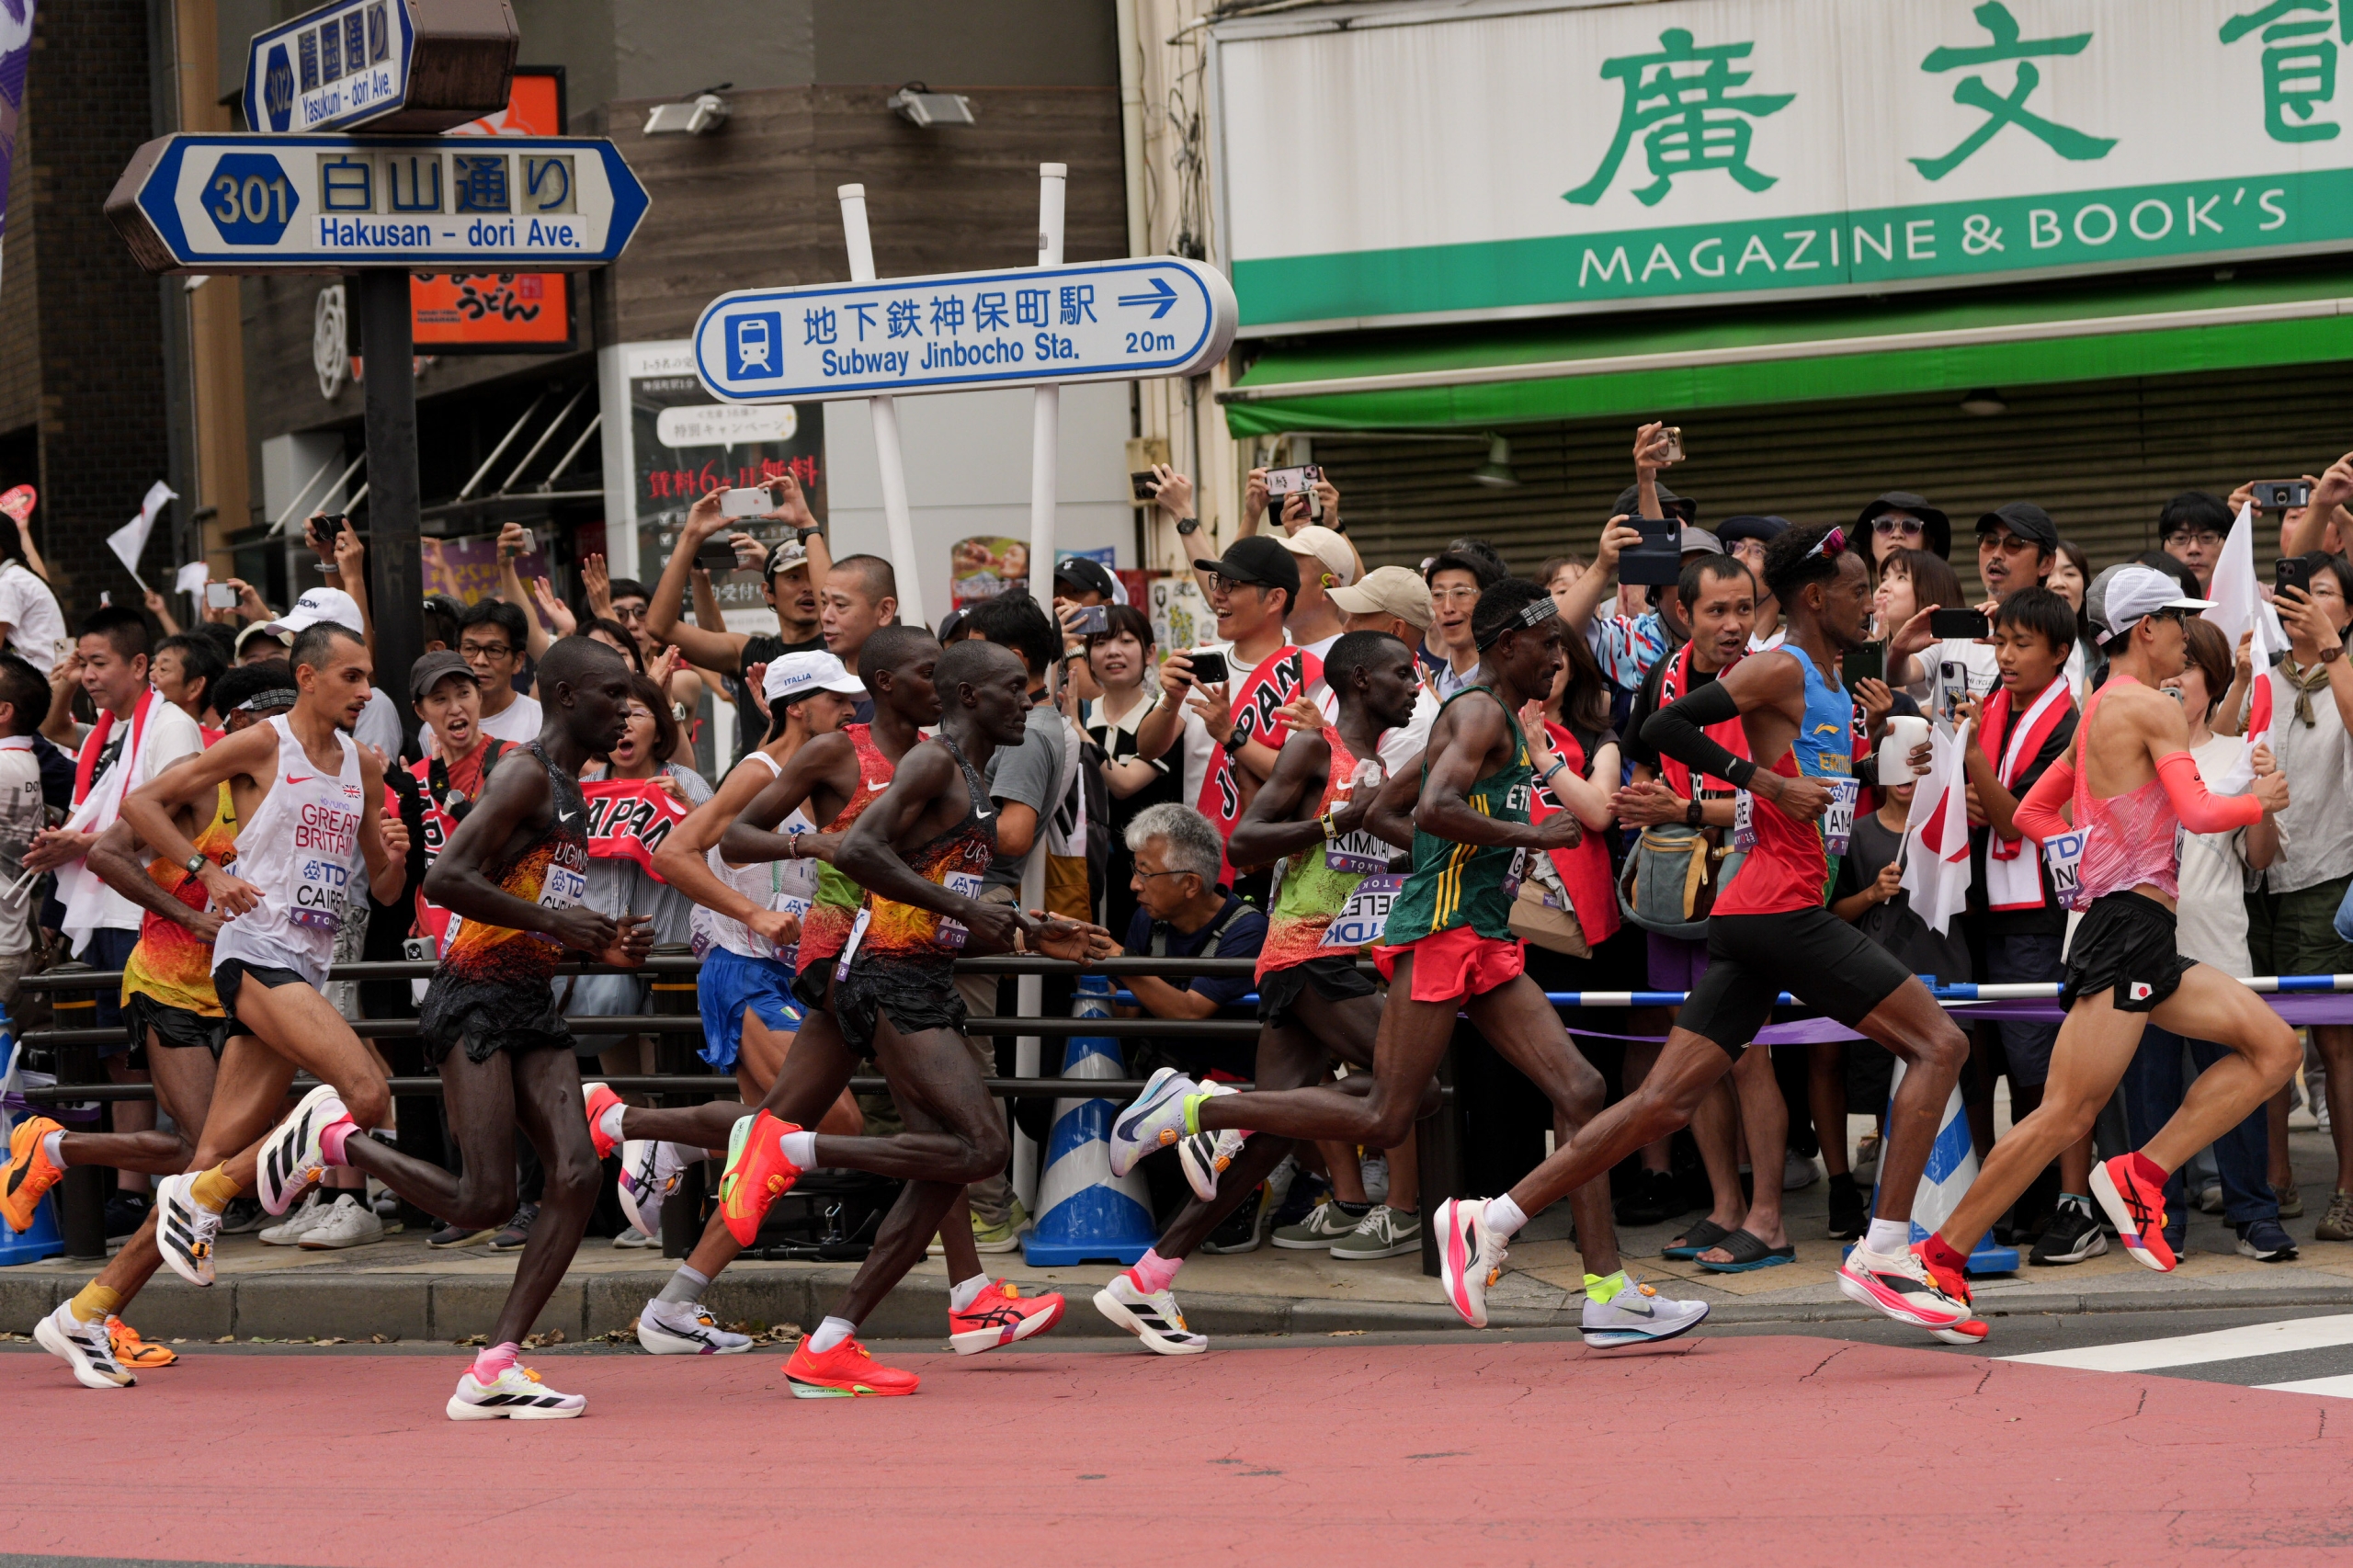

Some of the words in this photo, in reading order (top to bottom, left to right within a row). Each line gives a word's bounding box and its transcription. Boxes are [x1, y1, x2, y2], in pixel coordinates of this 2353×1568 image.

[268, 63, 292, 116] 302
[302, 84, 341, 125] Yasukuni
[352, 74, 369, 106] dori
[372, 70, 392, 100] Ave.
[214, 175, 288, 224] 301
[323, 154, 569, 211] 白山通り
[321, 218, 431, 246] Hakusan
[468, 219, 515, 246] dori
[527, 219, 580, 248] Ave.
[1578, 219, 1938, 289] MAGAZINE
[1961, 214, 2006, 256] &
[2029, 187, 2287, 250] BOOK'S
[456, 286, 540, 322] うどん
[803, 284, 1098, 346] 地下鉄神保町駅
[822, 347, 909, 377] Subway
[920, 336, 1024, 369] Jinbocho
[1035, 332, 1080, 361] Sta.
[1125, 331, 1176, 354] 20m
[783, 672, 813, 687] ITALIA
[296, 825, 354, 858] BRITAIN
[301, 803, 360, 836] GREAT
